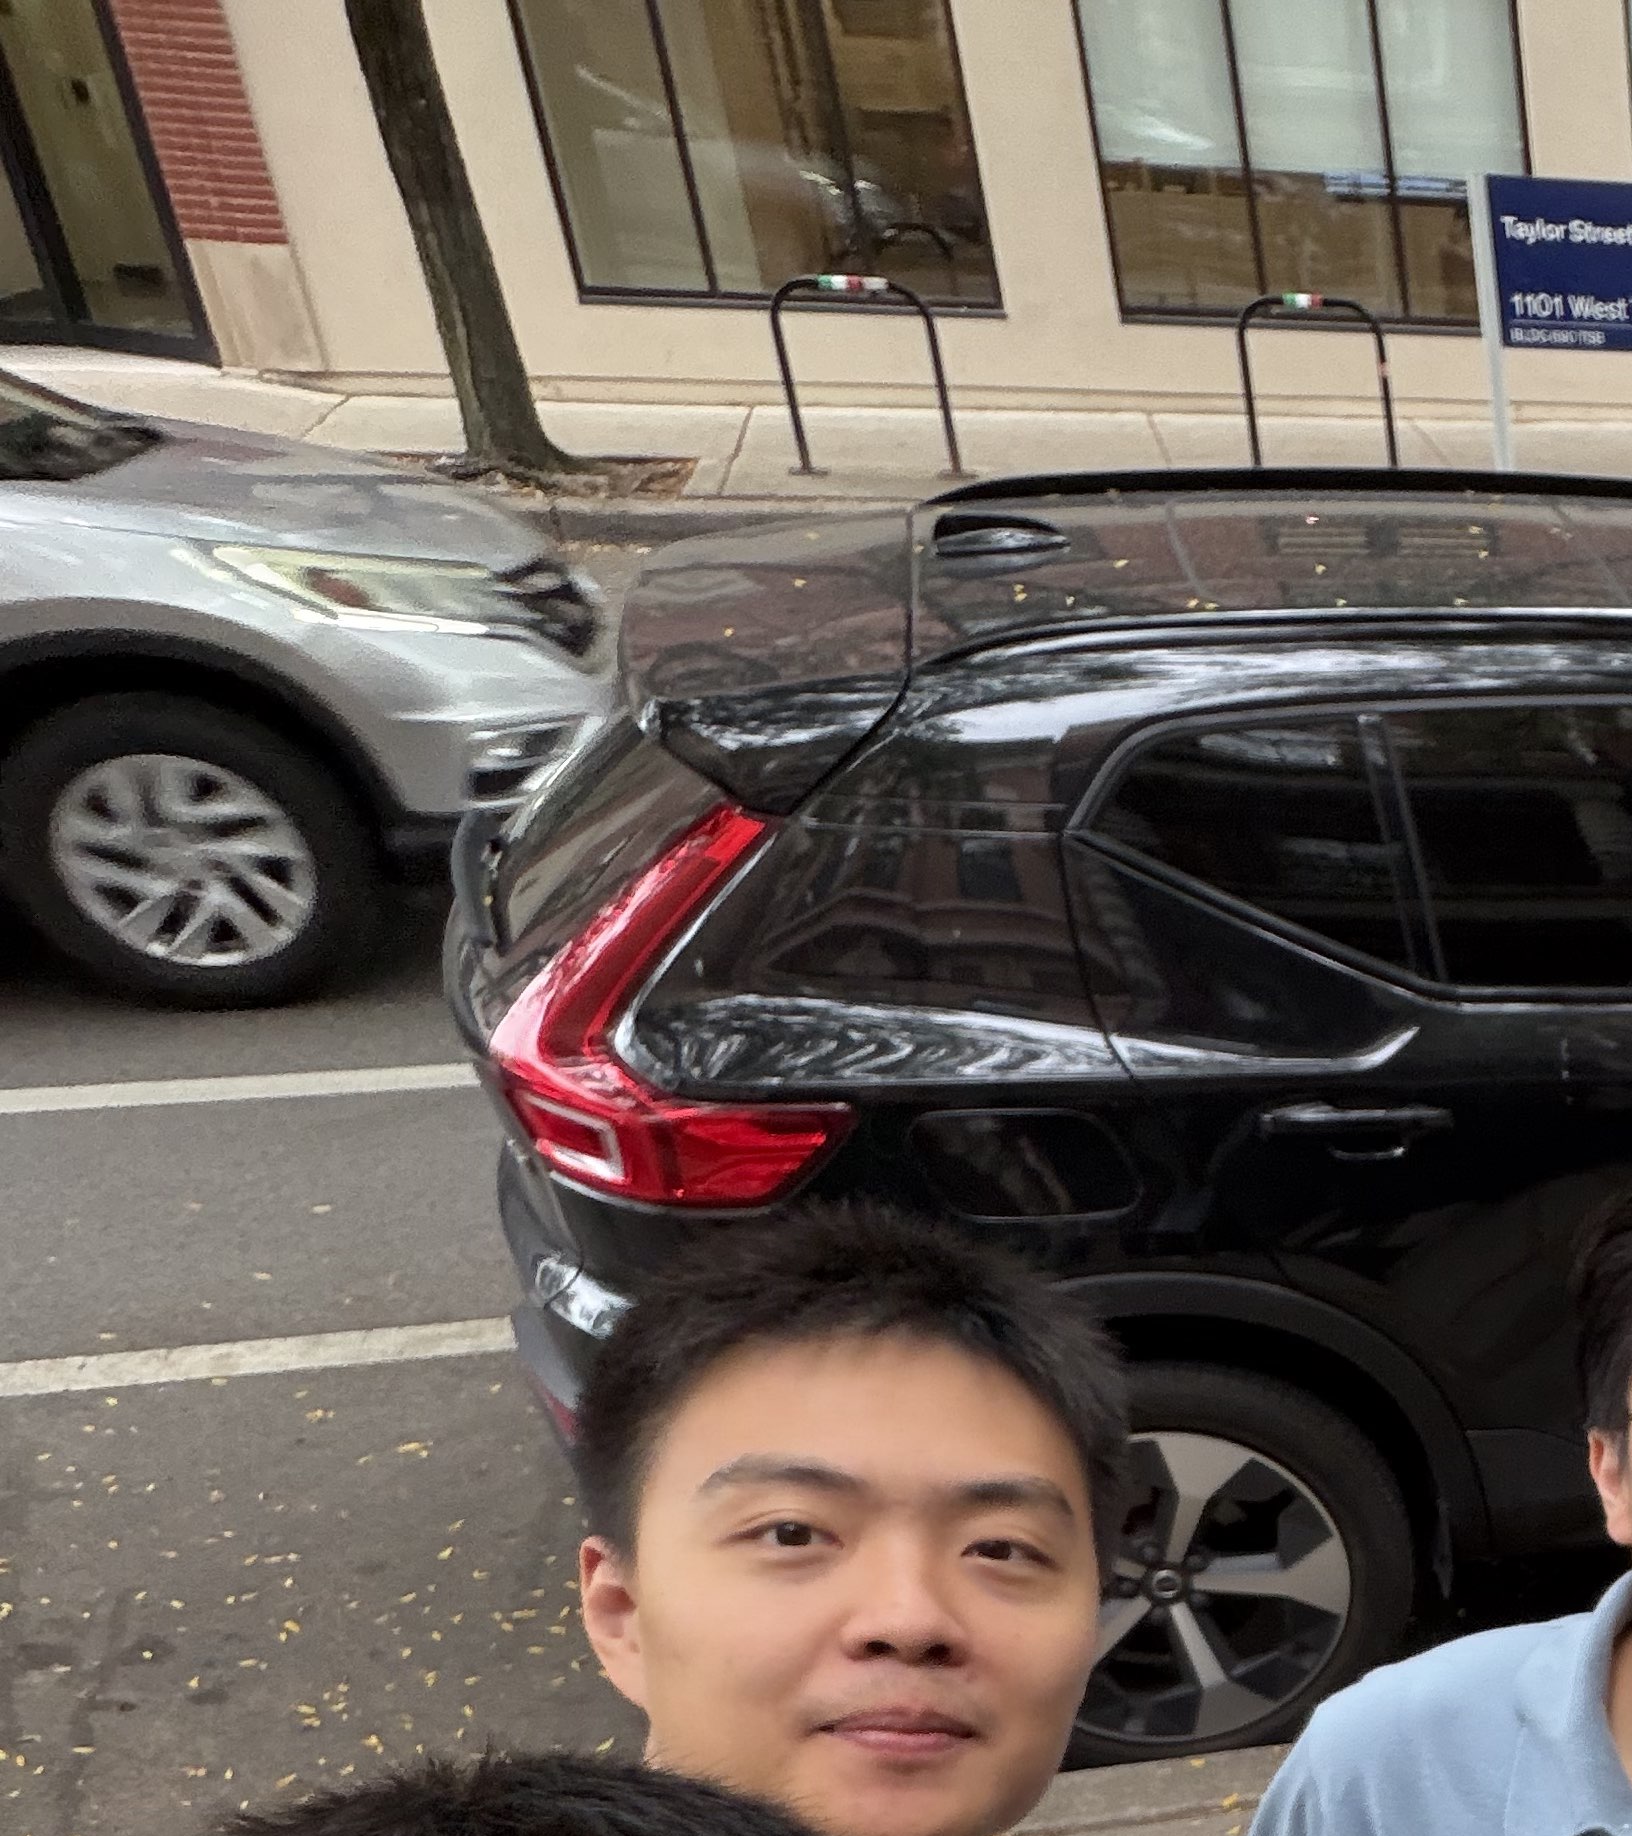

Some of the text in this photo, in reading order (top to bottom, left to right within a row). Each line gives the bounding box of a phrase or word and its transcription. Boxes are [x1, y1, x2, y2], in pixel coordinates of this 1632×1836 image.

[1500, 215, 1567, 246] Taylor
[1510, 293, 1564, 318] 1101
[1567, 295, 1629, 320] West
